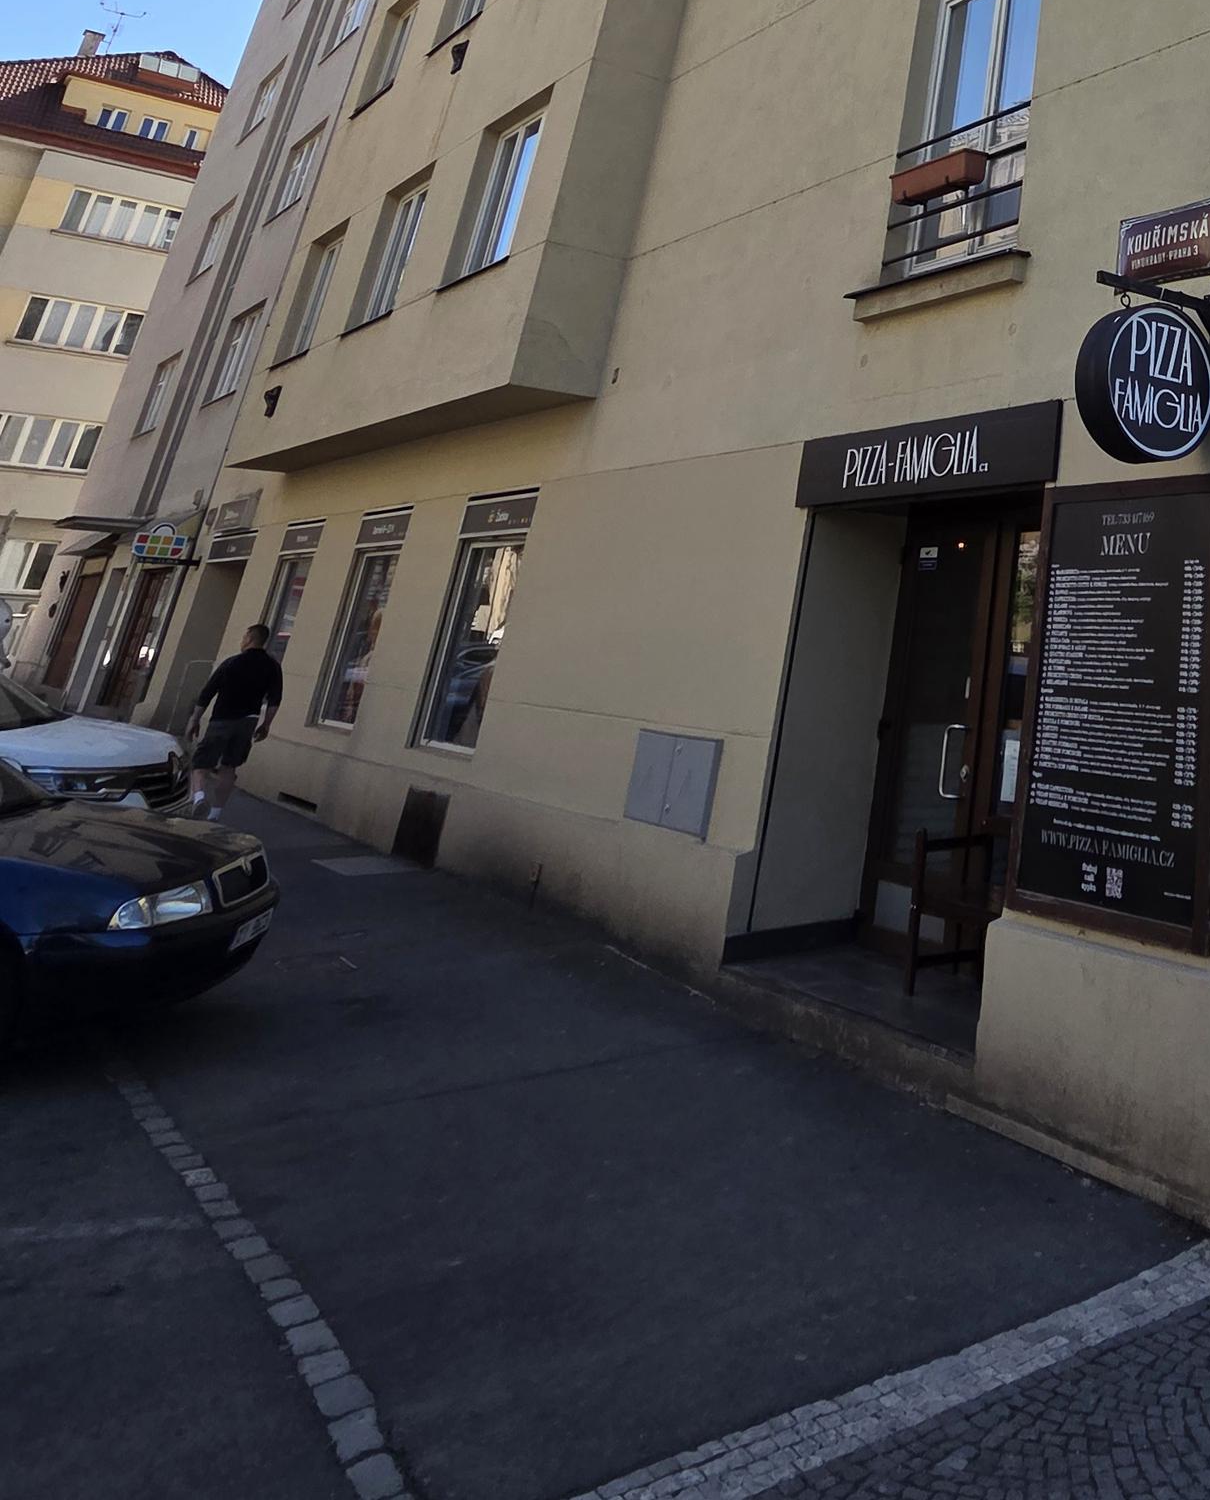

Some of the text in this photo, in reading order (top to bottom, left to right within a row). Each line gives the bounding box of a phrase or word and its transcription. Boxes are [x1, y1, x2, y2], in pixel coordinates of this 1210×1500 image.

[1127, 213, 1209, 256] KOUŘIMSKÁ
[1193, 244, 1199, 256] 3
[1129, 315, 1193, 386] PIZZA
[1114, 376, 1202, 434] FAMIGLIA
[1100, 532, 1151, 556] MENU
